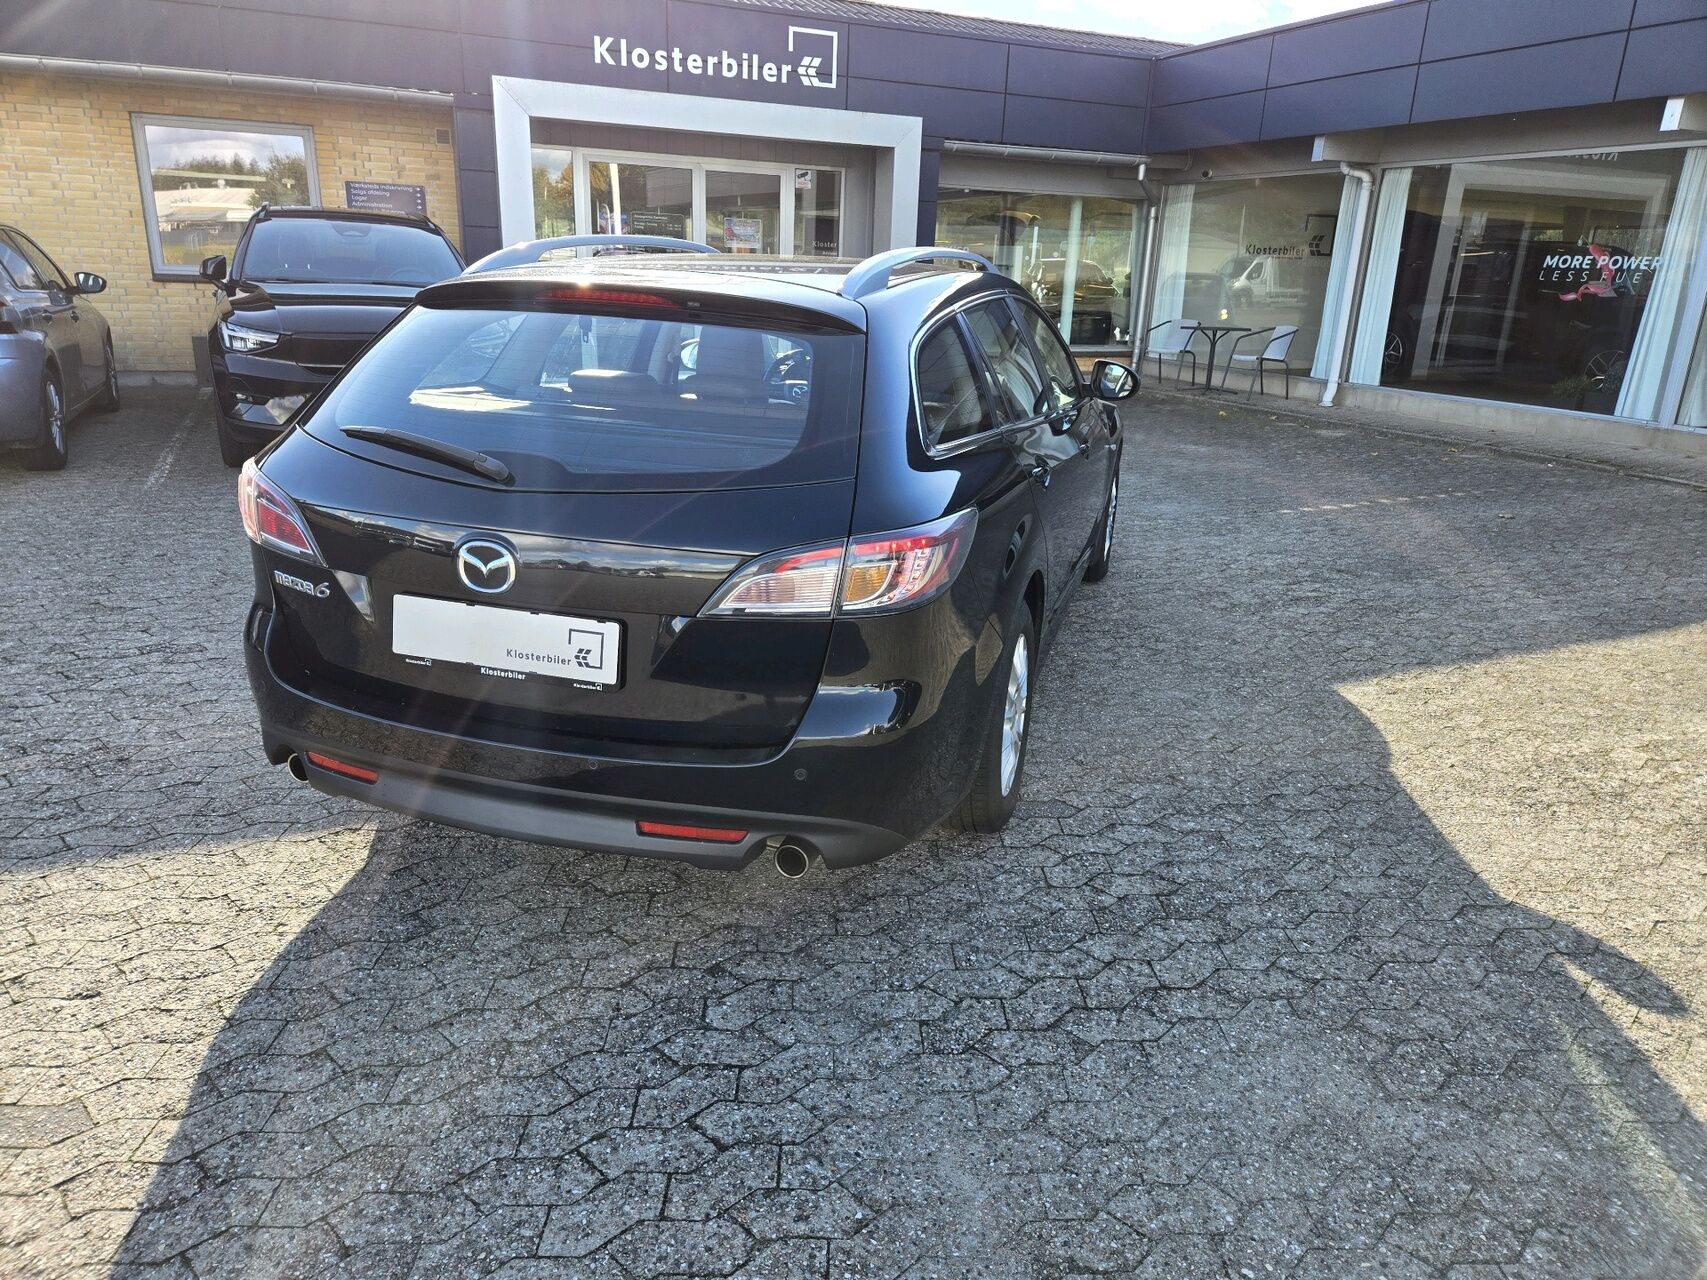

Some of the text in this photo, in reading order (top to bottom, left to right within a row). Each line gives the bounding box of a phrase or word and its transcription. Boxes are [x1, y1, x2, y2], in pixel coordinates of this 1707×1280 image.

[593, 35, 792, 84] Klosterbiler
[1245, 243, 1305, 256] Klosterbiler
[1543, 255, 1664, 270] MORE POWER
[1539, 270, 1643, 284] LESS FUE
[506, 648, 572, 666] Klosterbiler
[480, 667, 526, 680] Klosterbiler
